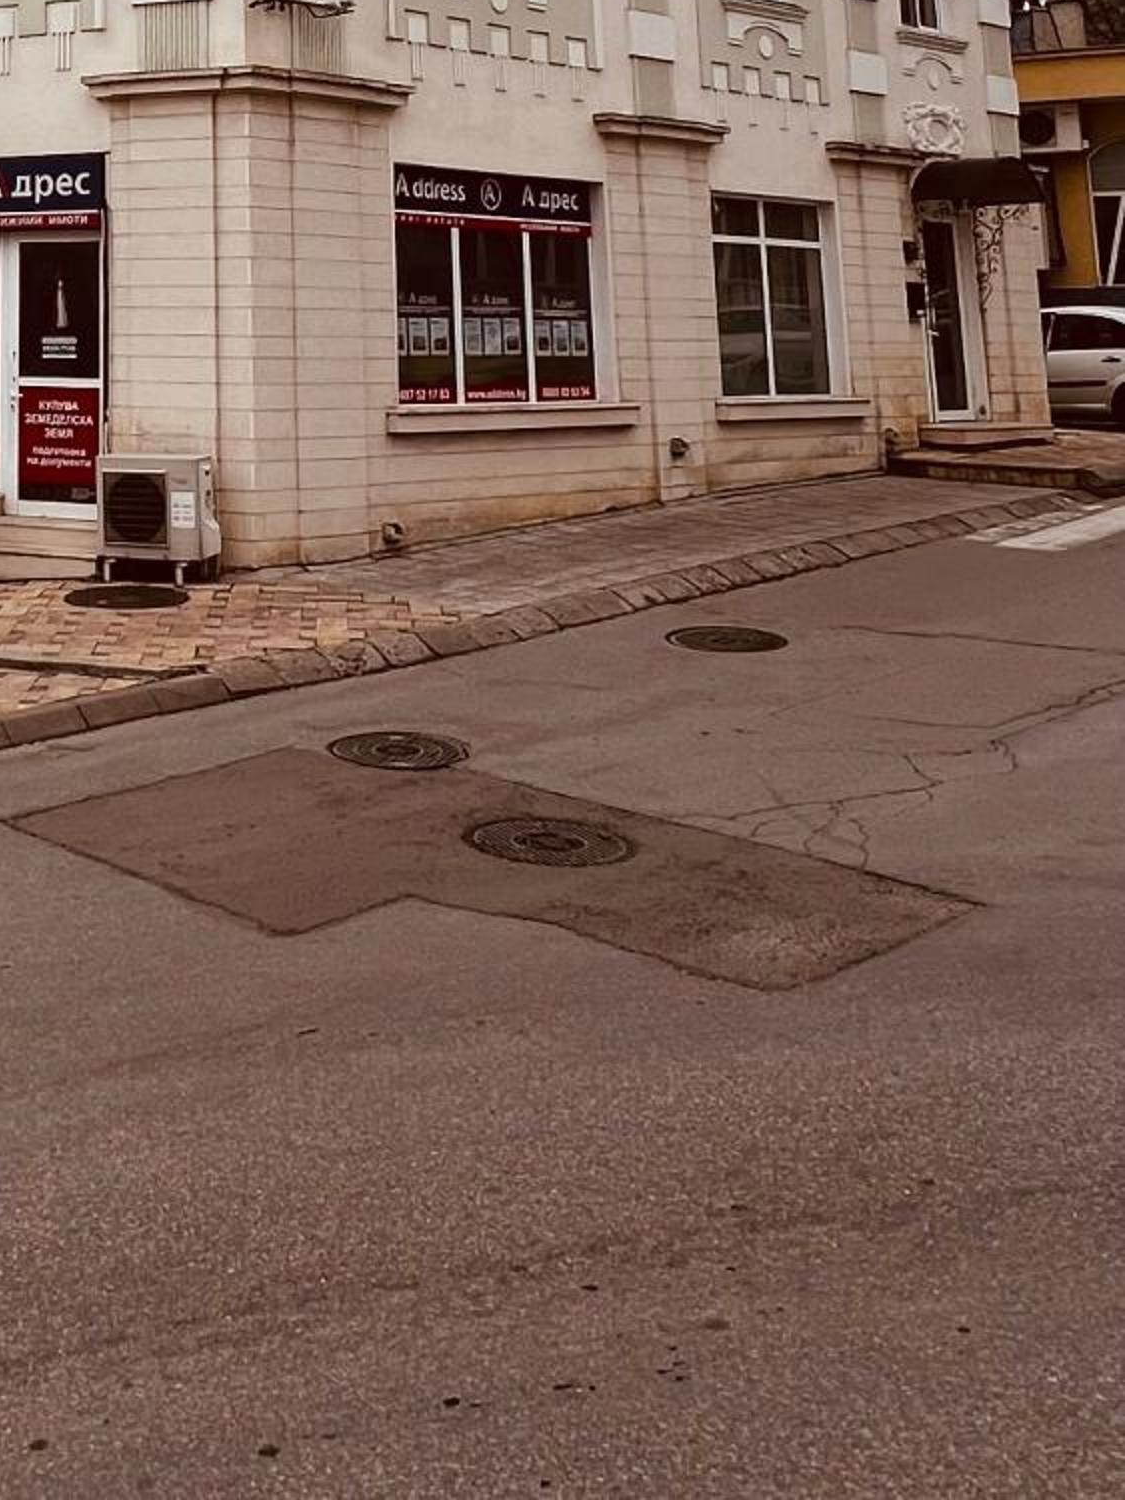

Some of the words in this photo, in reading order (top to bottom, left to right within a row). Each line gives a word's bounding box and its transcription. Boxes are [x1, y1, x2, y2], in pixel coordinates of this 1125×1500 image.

[396, 172, 466, 202] Address
[522, 184, 579, 214] Адрес
[48, 215, 88, 225] имоти
